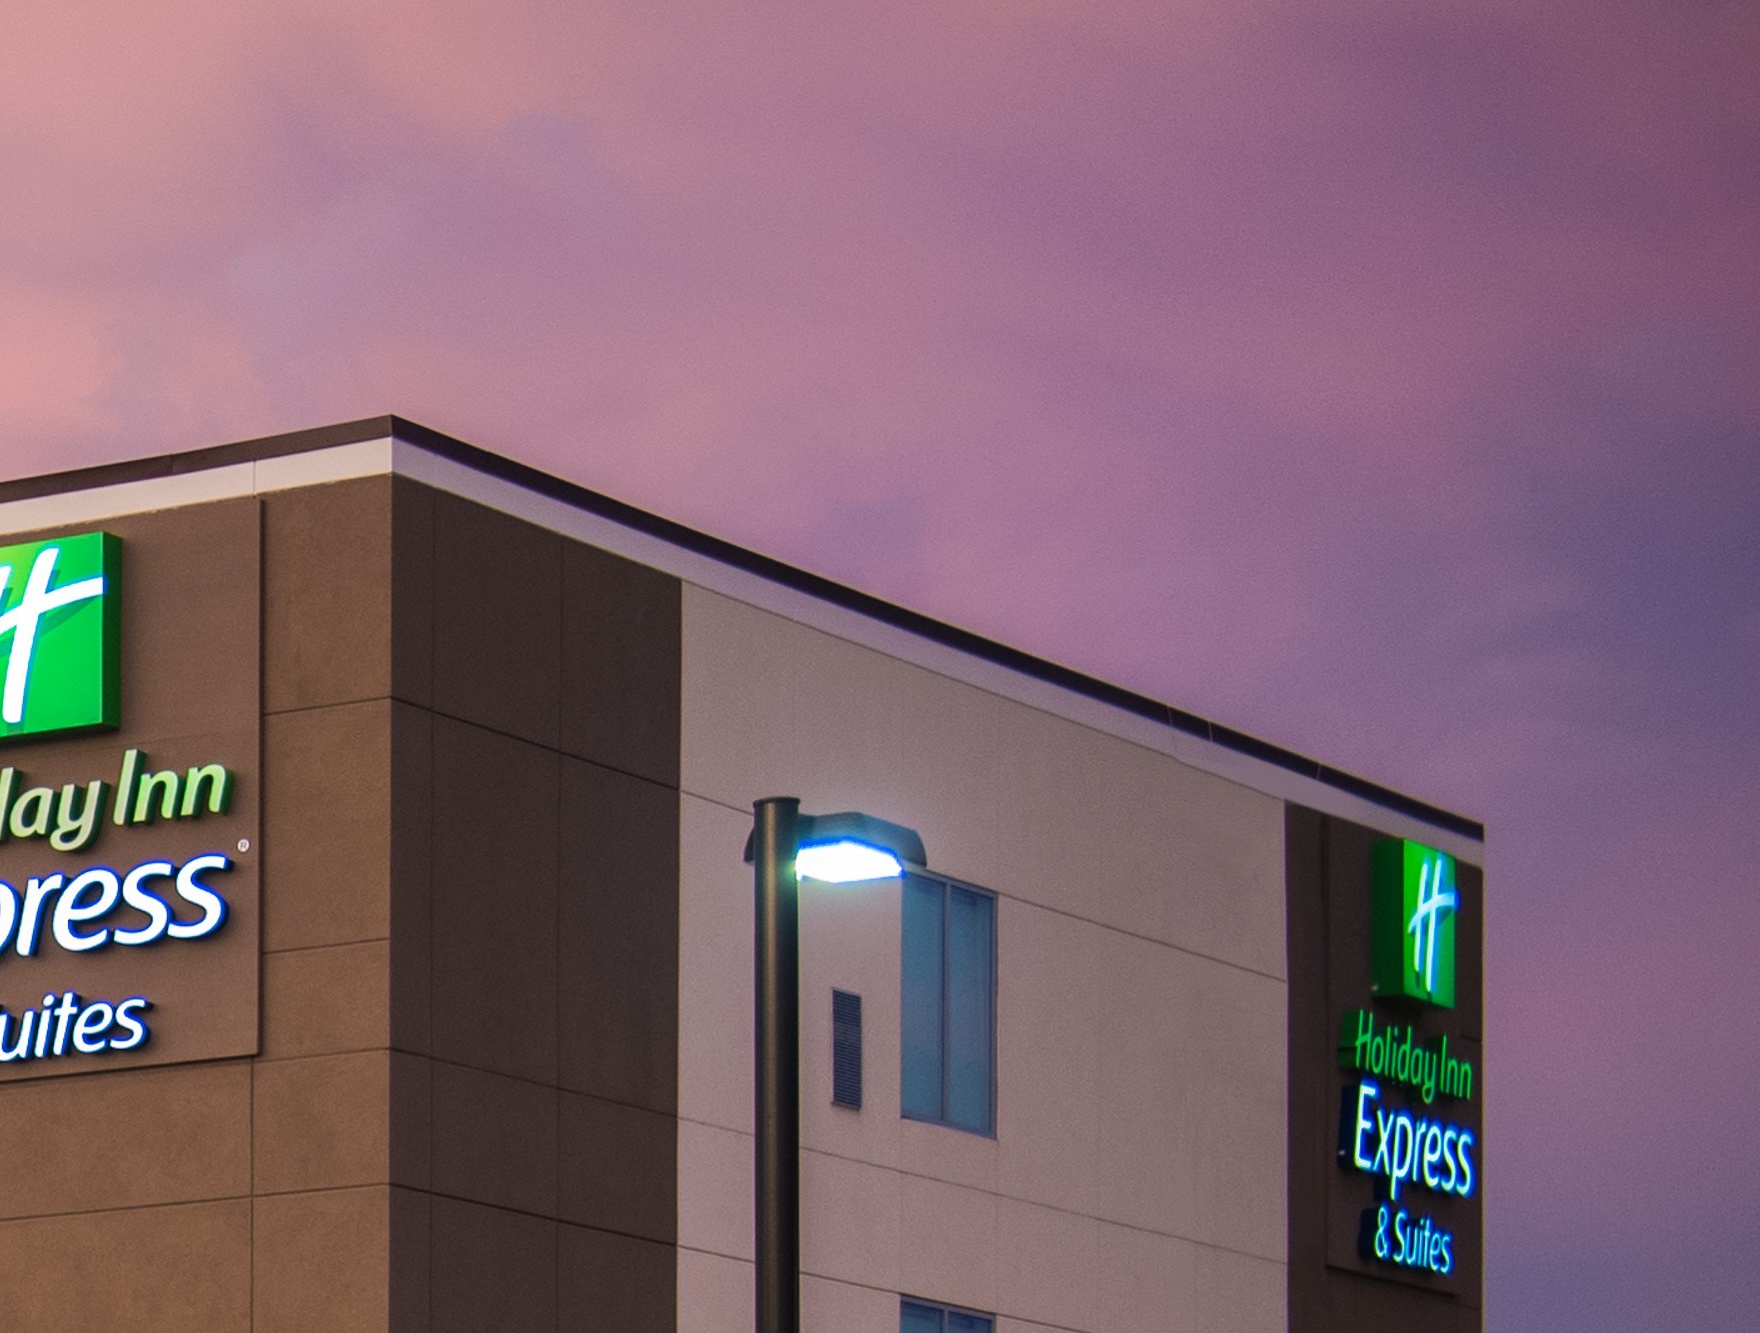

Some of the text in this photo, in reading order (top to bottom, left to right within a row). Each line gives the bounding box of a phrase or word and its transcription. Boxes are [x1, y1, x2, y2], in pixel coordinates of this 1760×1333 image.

[113, 749, 229, 827] Inn
[1355, 1009, 1473, 1105] Holiday Inn
[1354, 1084, 1473, 1200] Express
[1375, 1206, 1452, 1274] & Suites
